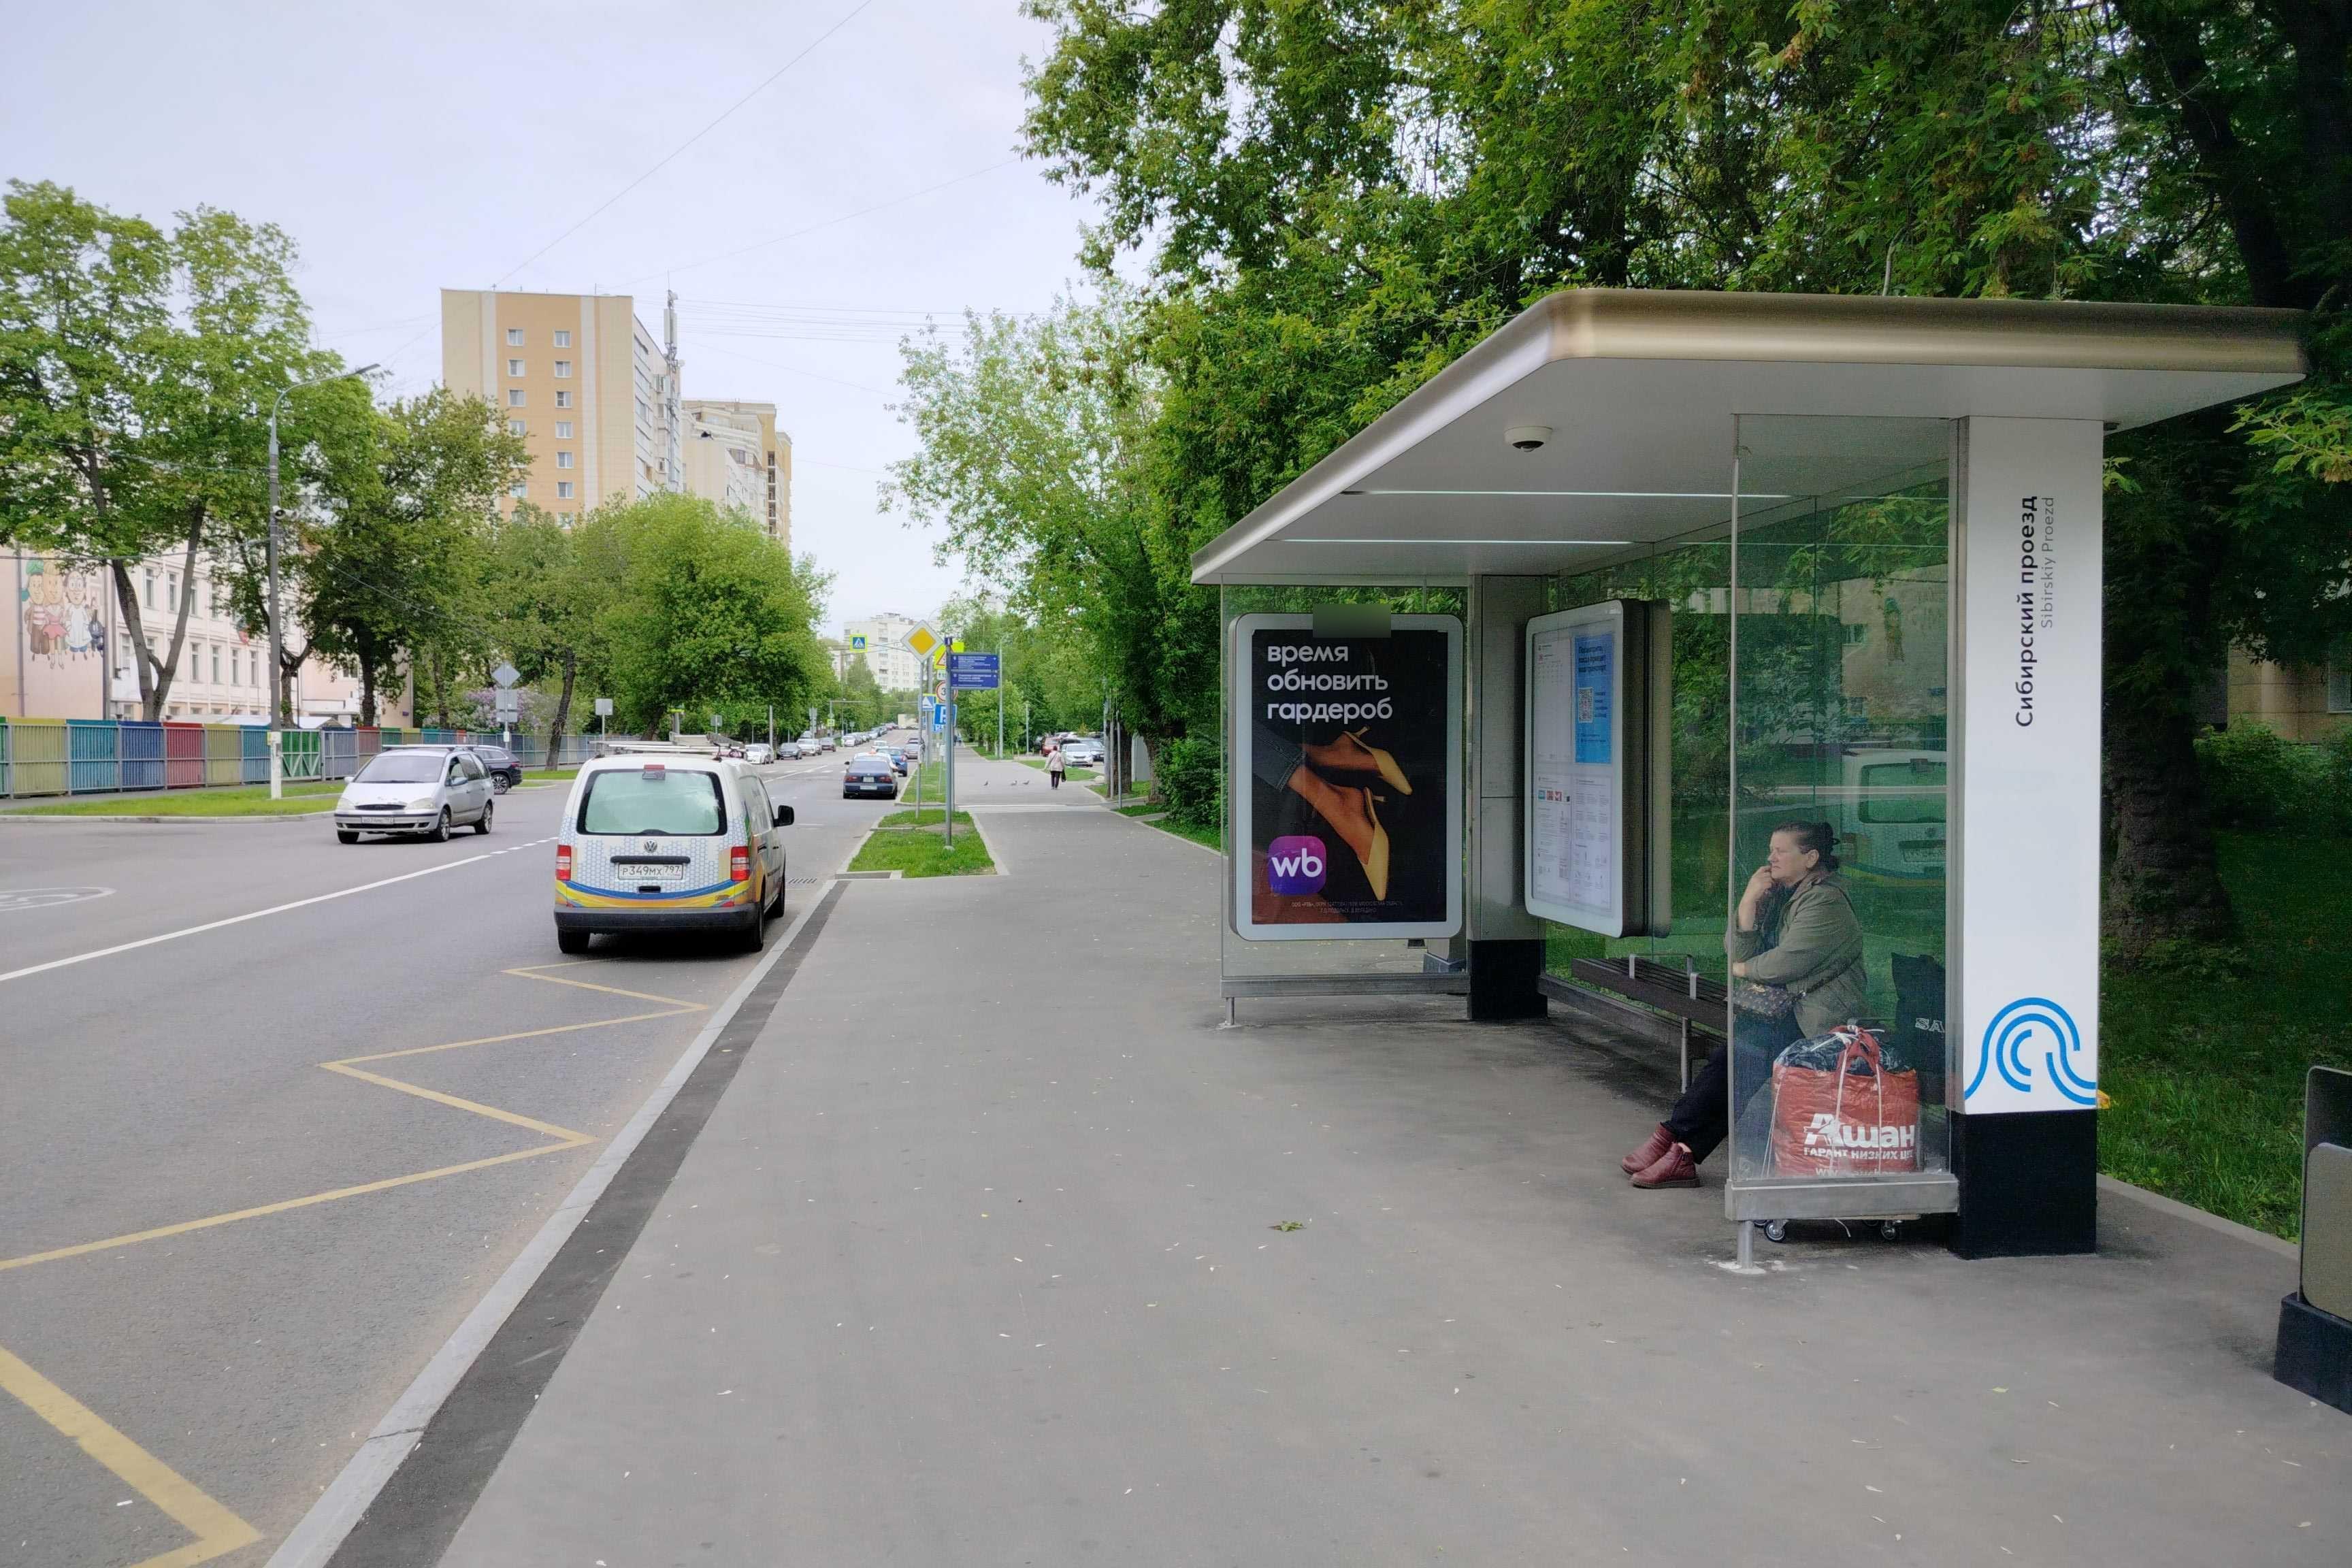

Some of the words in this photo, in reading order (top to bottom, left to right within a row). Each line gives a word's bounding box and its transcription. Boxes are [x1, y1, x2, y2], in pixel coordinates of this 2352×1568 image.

[2020, 495, 2038, 584] проезд
[2041, 496, 2055, 553] Proezd
[2040, 556, 2056, 628] Sibirskiy
[1267, 644, 1349, 667] время
[2015, 593, 2038, 727] Сибирский
[1267, 668, 1388, 691] обновить
[1267, 698, 1393, 724] гардероб
[664, 865, 679, 873] 797
[1271, 847, 1323, 877] wb
[1803, 1113, 1915, 1148] Ашан
[1804, 1147, 1848, 1158] ГАРАНТ
[1850, 1149, 1897, 1160] НИЗКИХ
